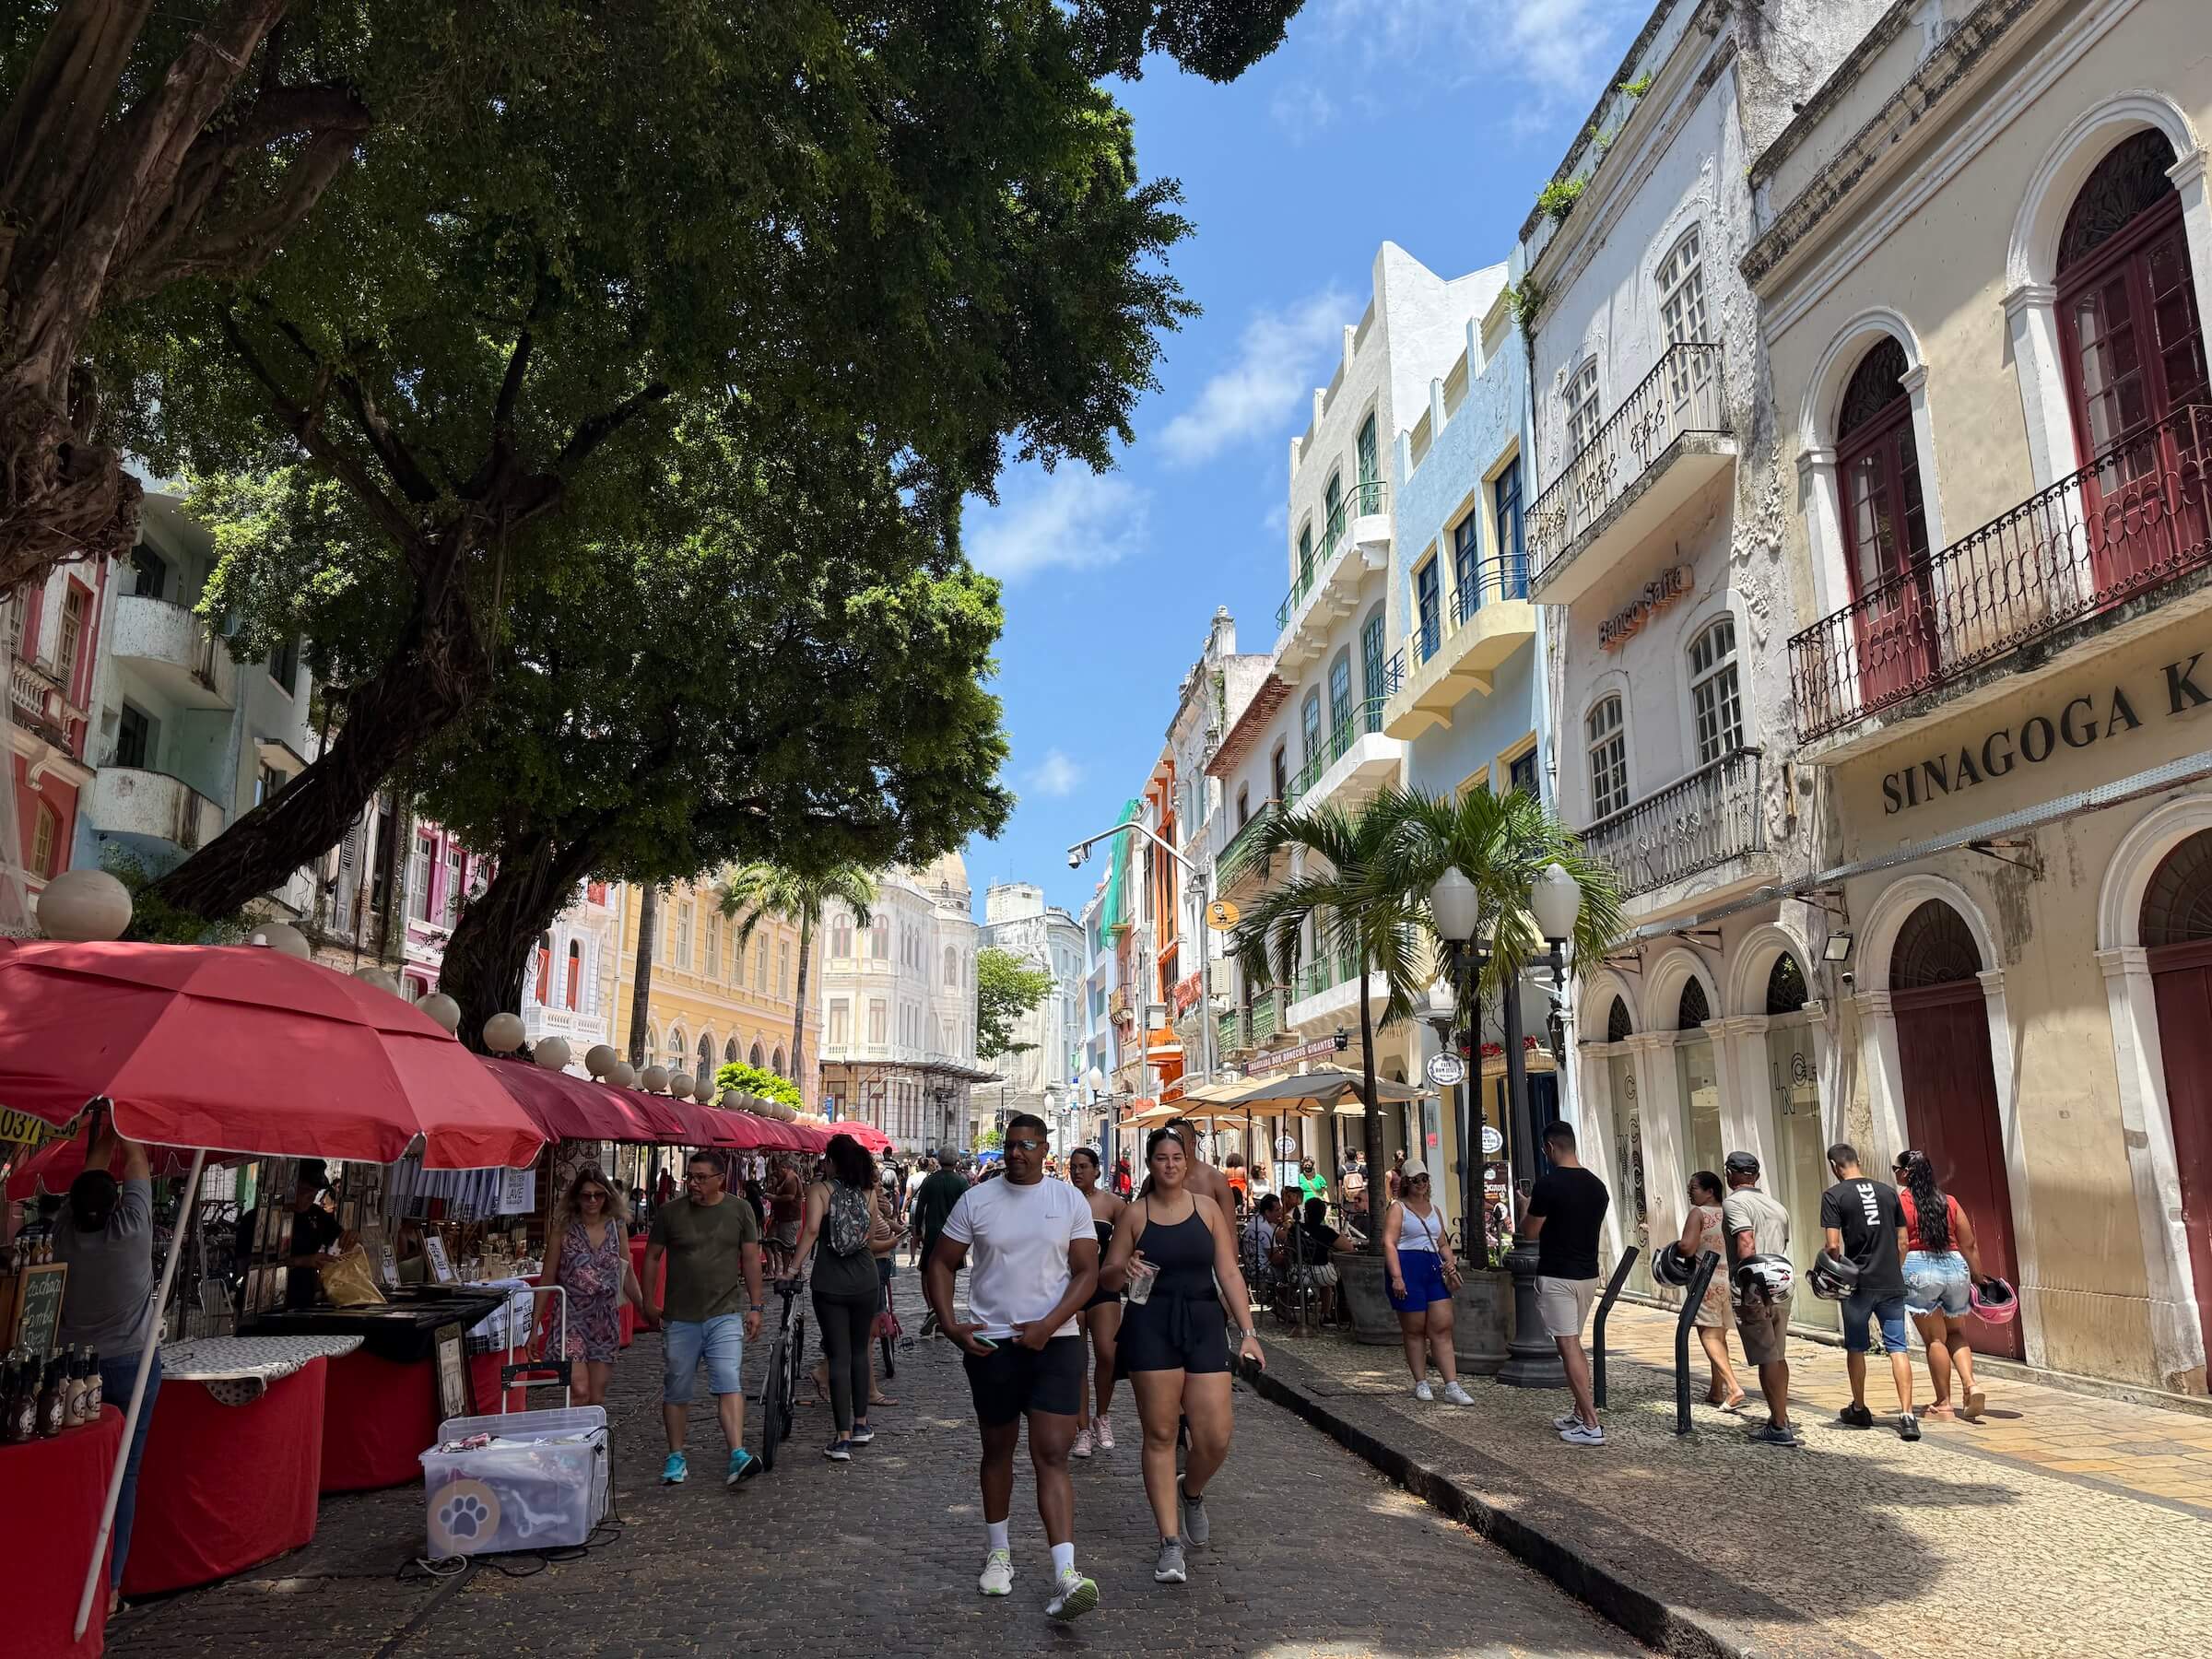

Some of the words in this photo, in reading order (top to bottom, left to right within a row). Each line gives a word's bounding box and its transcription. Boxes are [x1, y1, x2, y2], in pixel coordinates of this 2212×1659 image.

[1597, 600, 1642, 650] Banco
[1882, 685, 2144, 817] SINAGOGA
[1307, 1038, 1335, 1054] GIGANTES
[1855, 1182, 1881, 1227] NIKE
